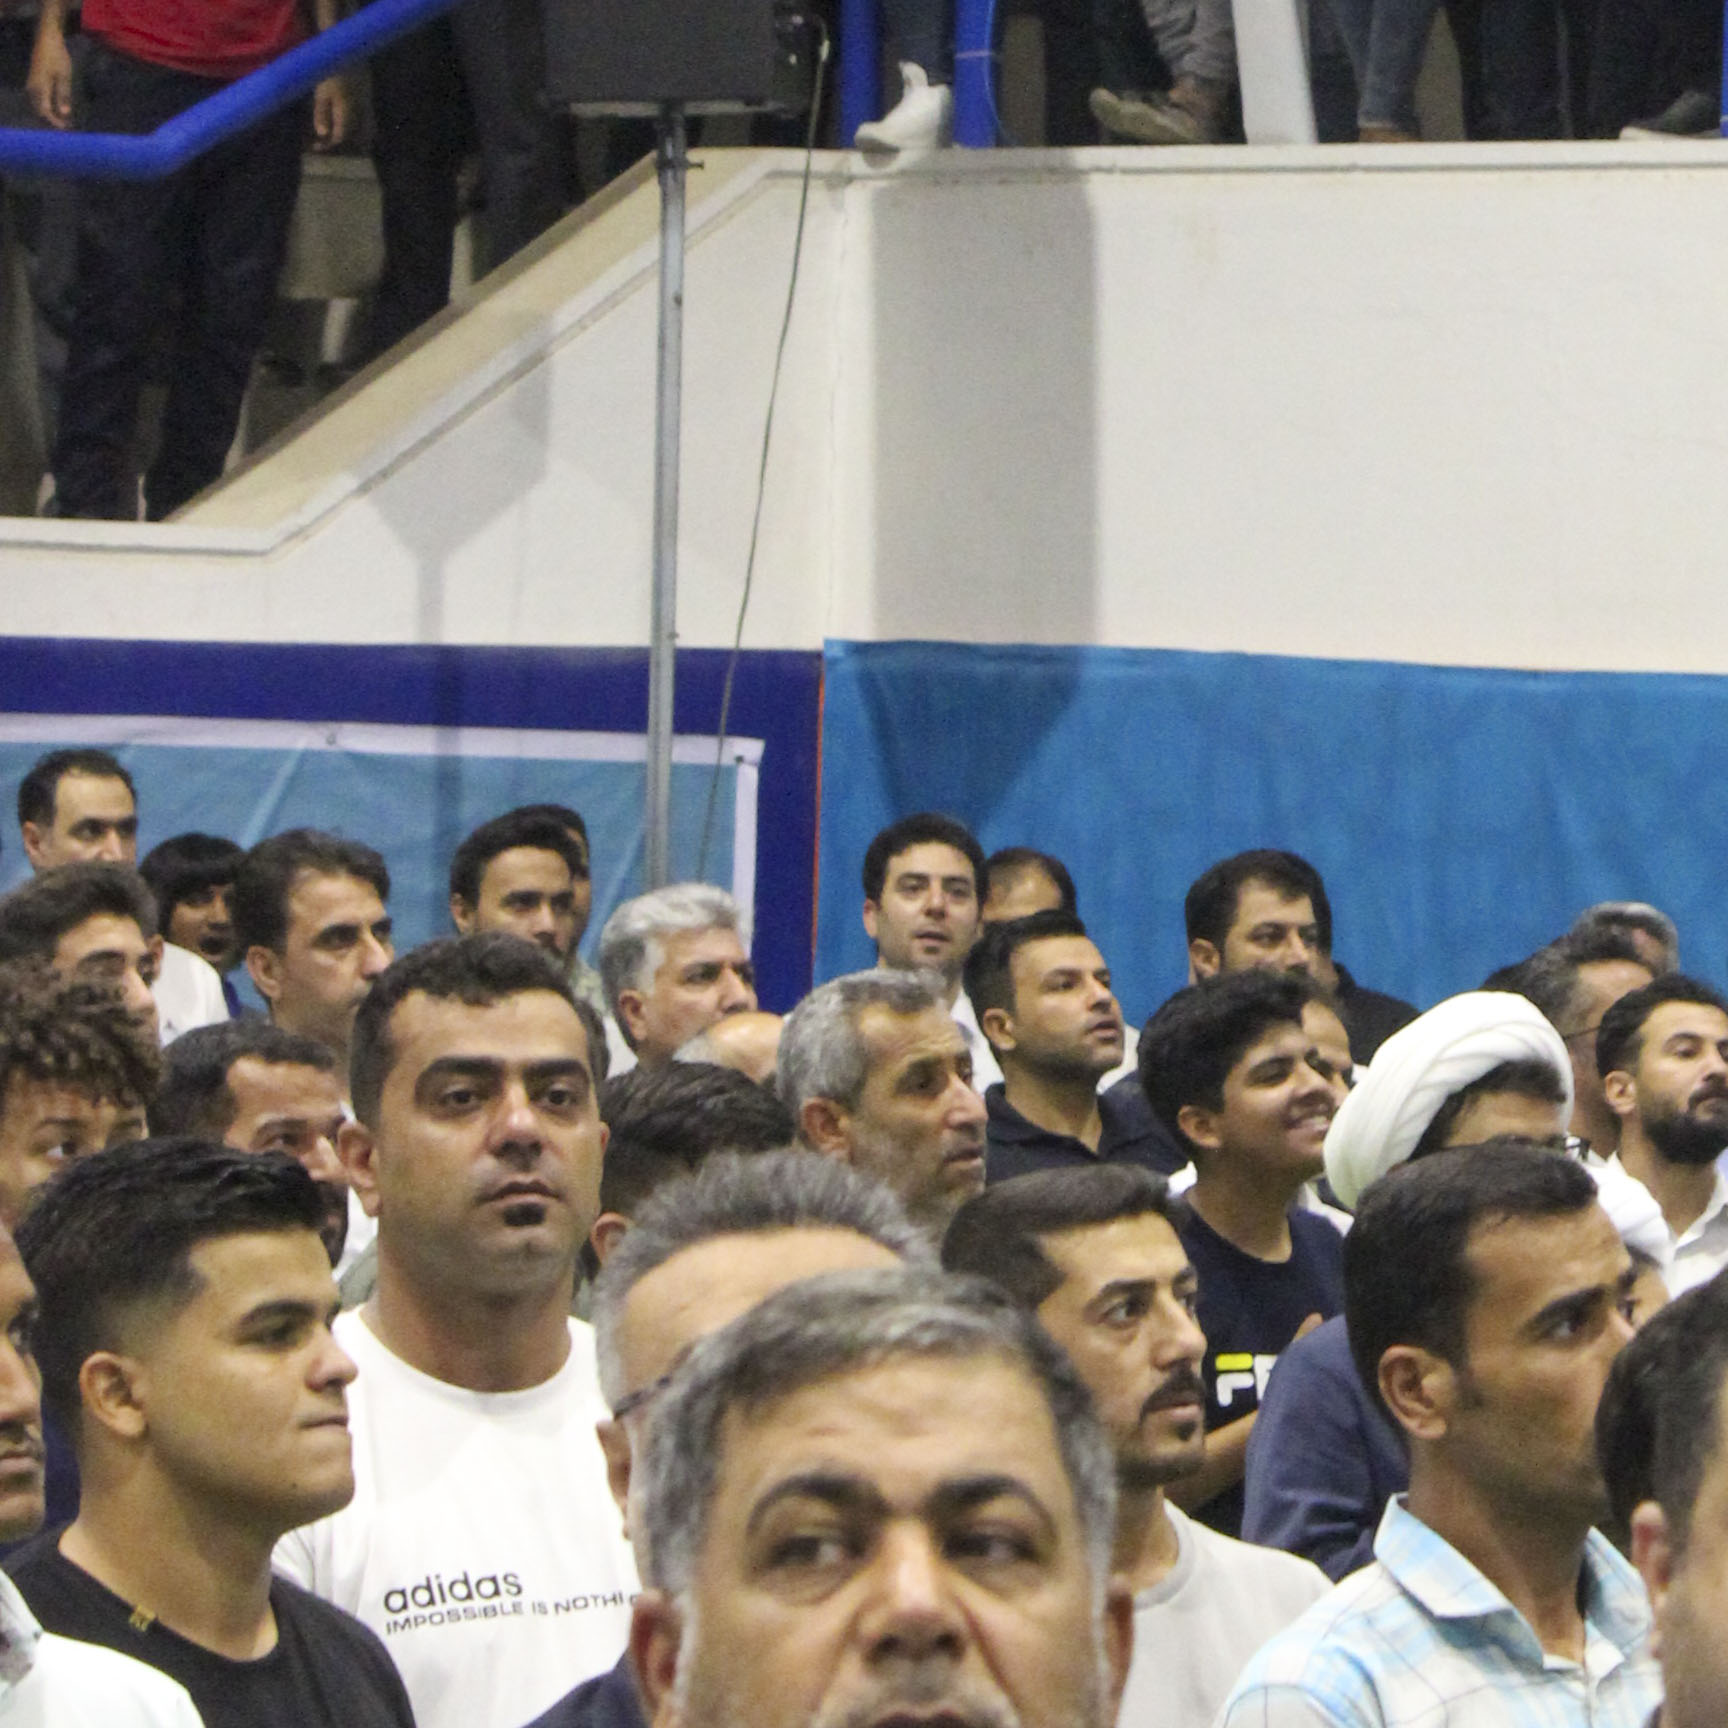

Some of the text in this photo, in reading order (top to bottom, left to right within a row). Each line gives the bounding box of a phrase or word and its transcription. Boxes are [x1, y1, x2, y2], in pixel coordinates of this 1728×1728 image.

[384, 1571, 523, 1615] adidas
[386, 1600, 524, 1636] IMPOSSIBLE
[532, 1599, 549, 1616] IS
